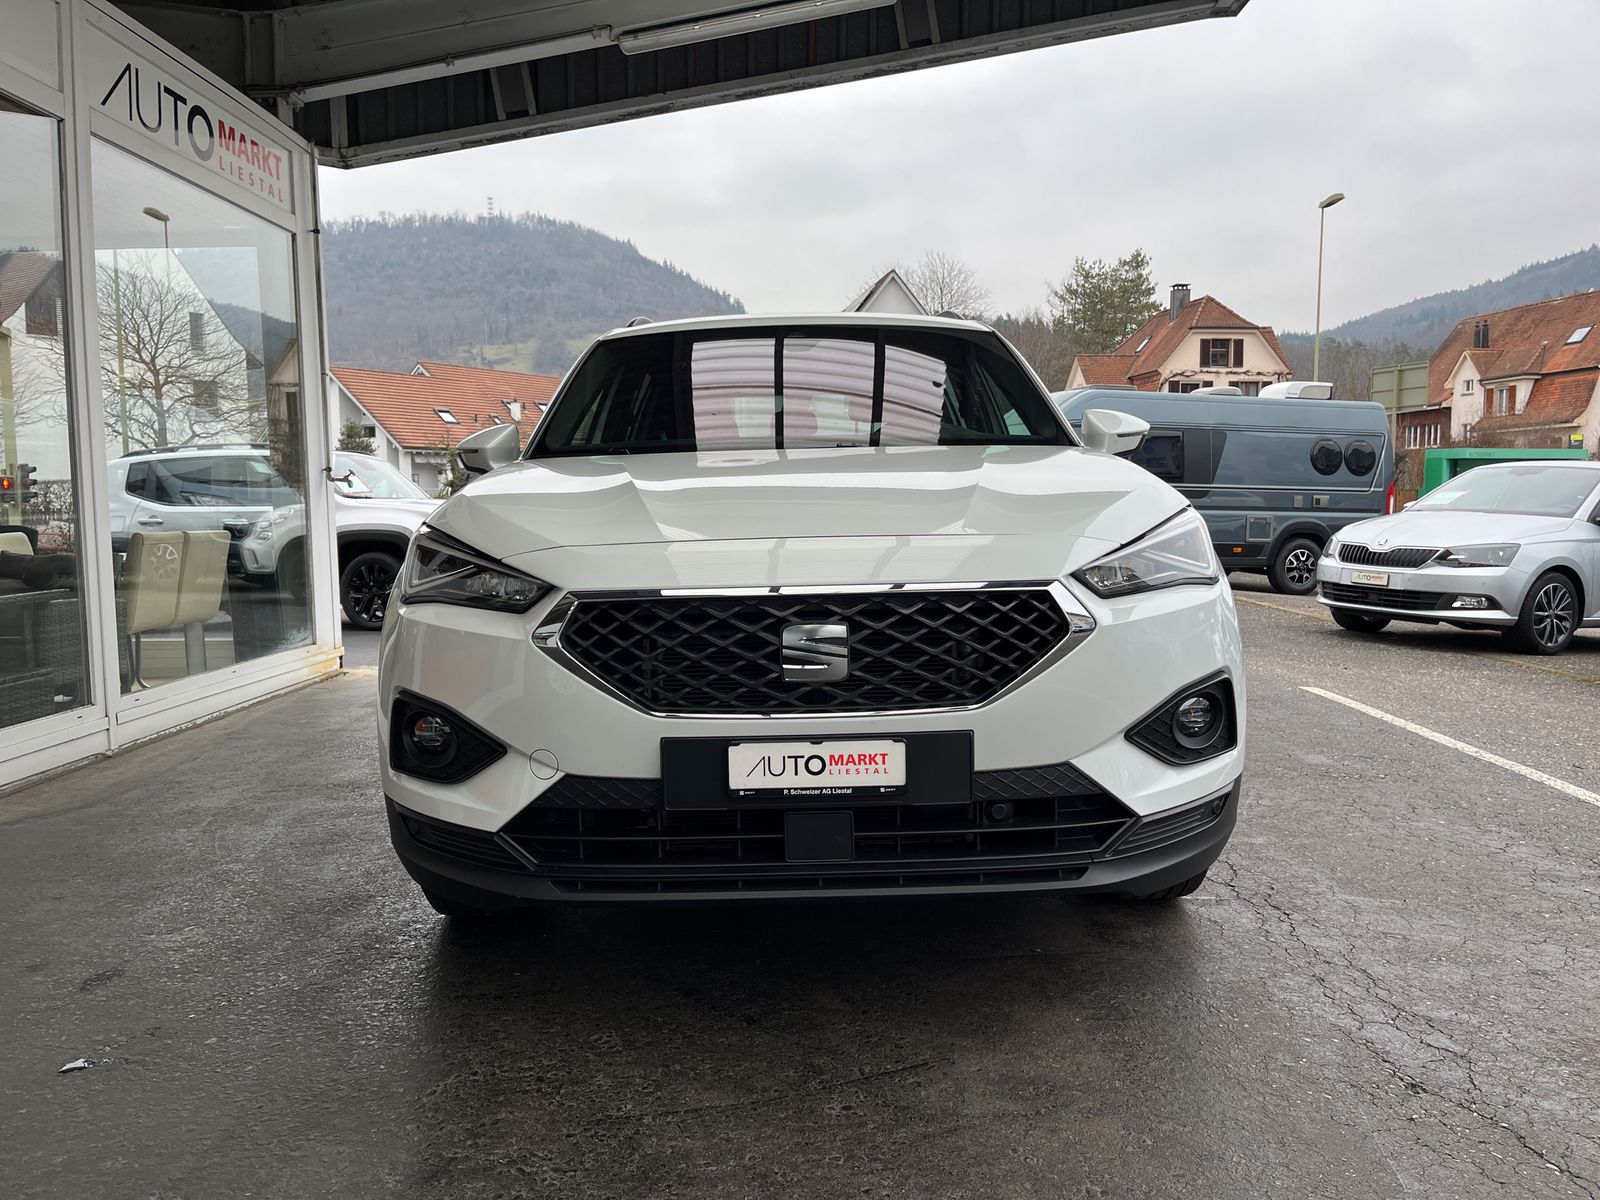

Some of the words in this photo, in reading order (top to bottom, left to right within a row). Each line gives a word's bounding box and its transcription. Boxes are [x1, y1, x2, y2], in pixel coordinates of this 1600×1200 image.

[101, 63, 215, 162] AUTO
[218, 119, 282, 181] MARKT
[219, 155, 284, 203] LIESTAL
[746, 754, 827, 777] AUTO
[828, 753, 889, 766] MARKT
[829, 767, 889, 776] LIESTAL
